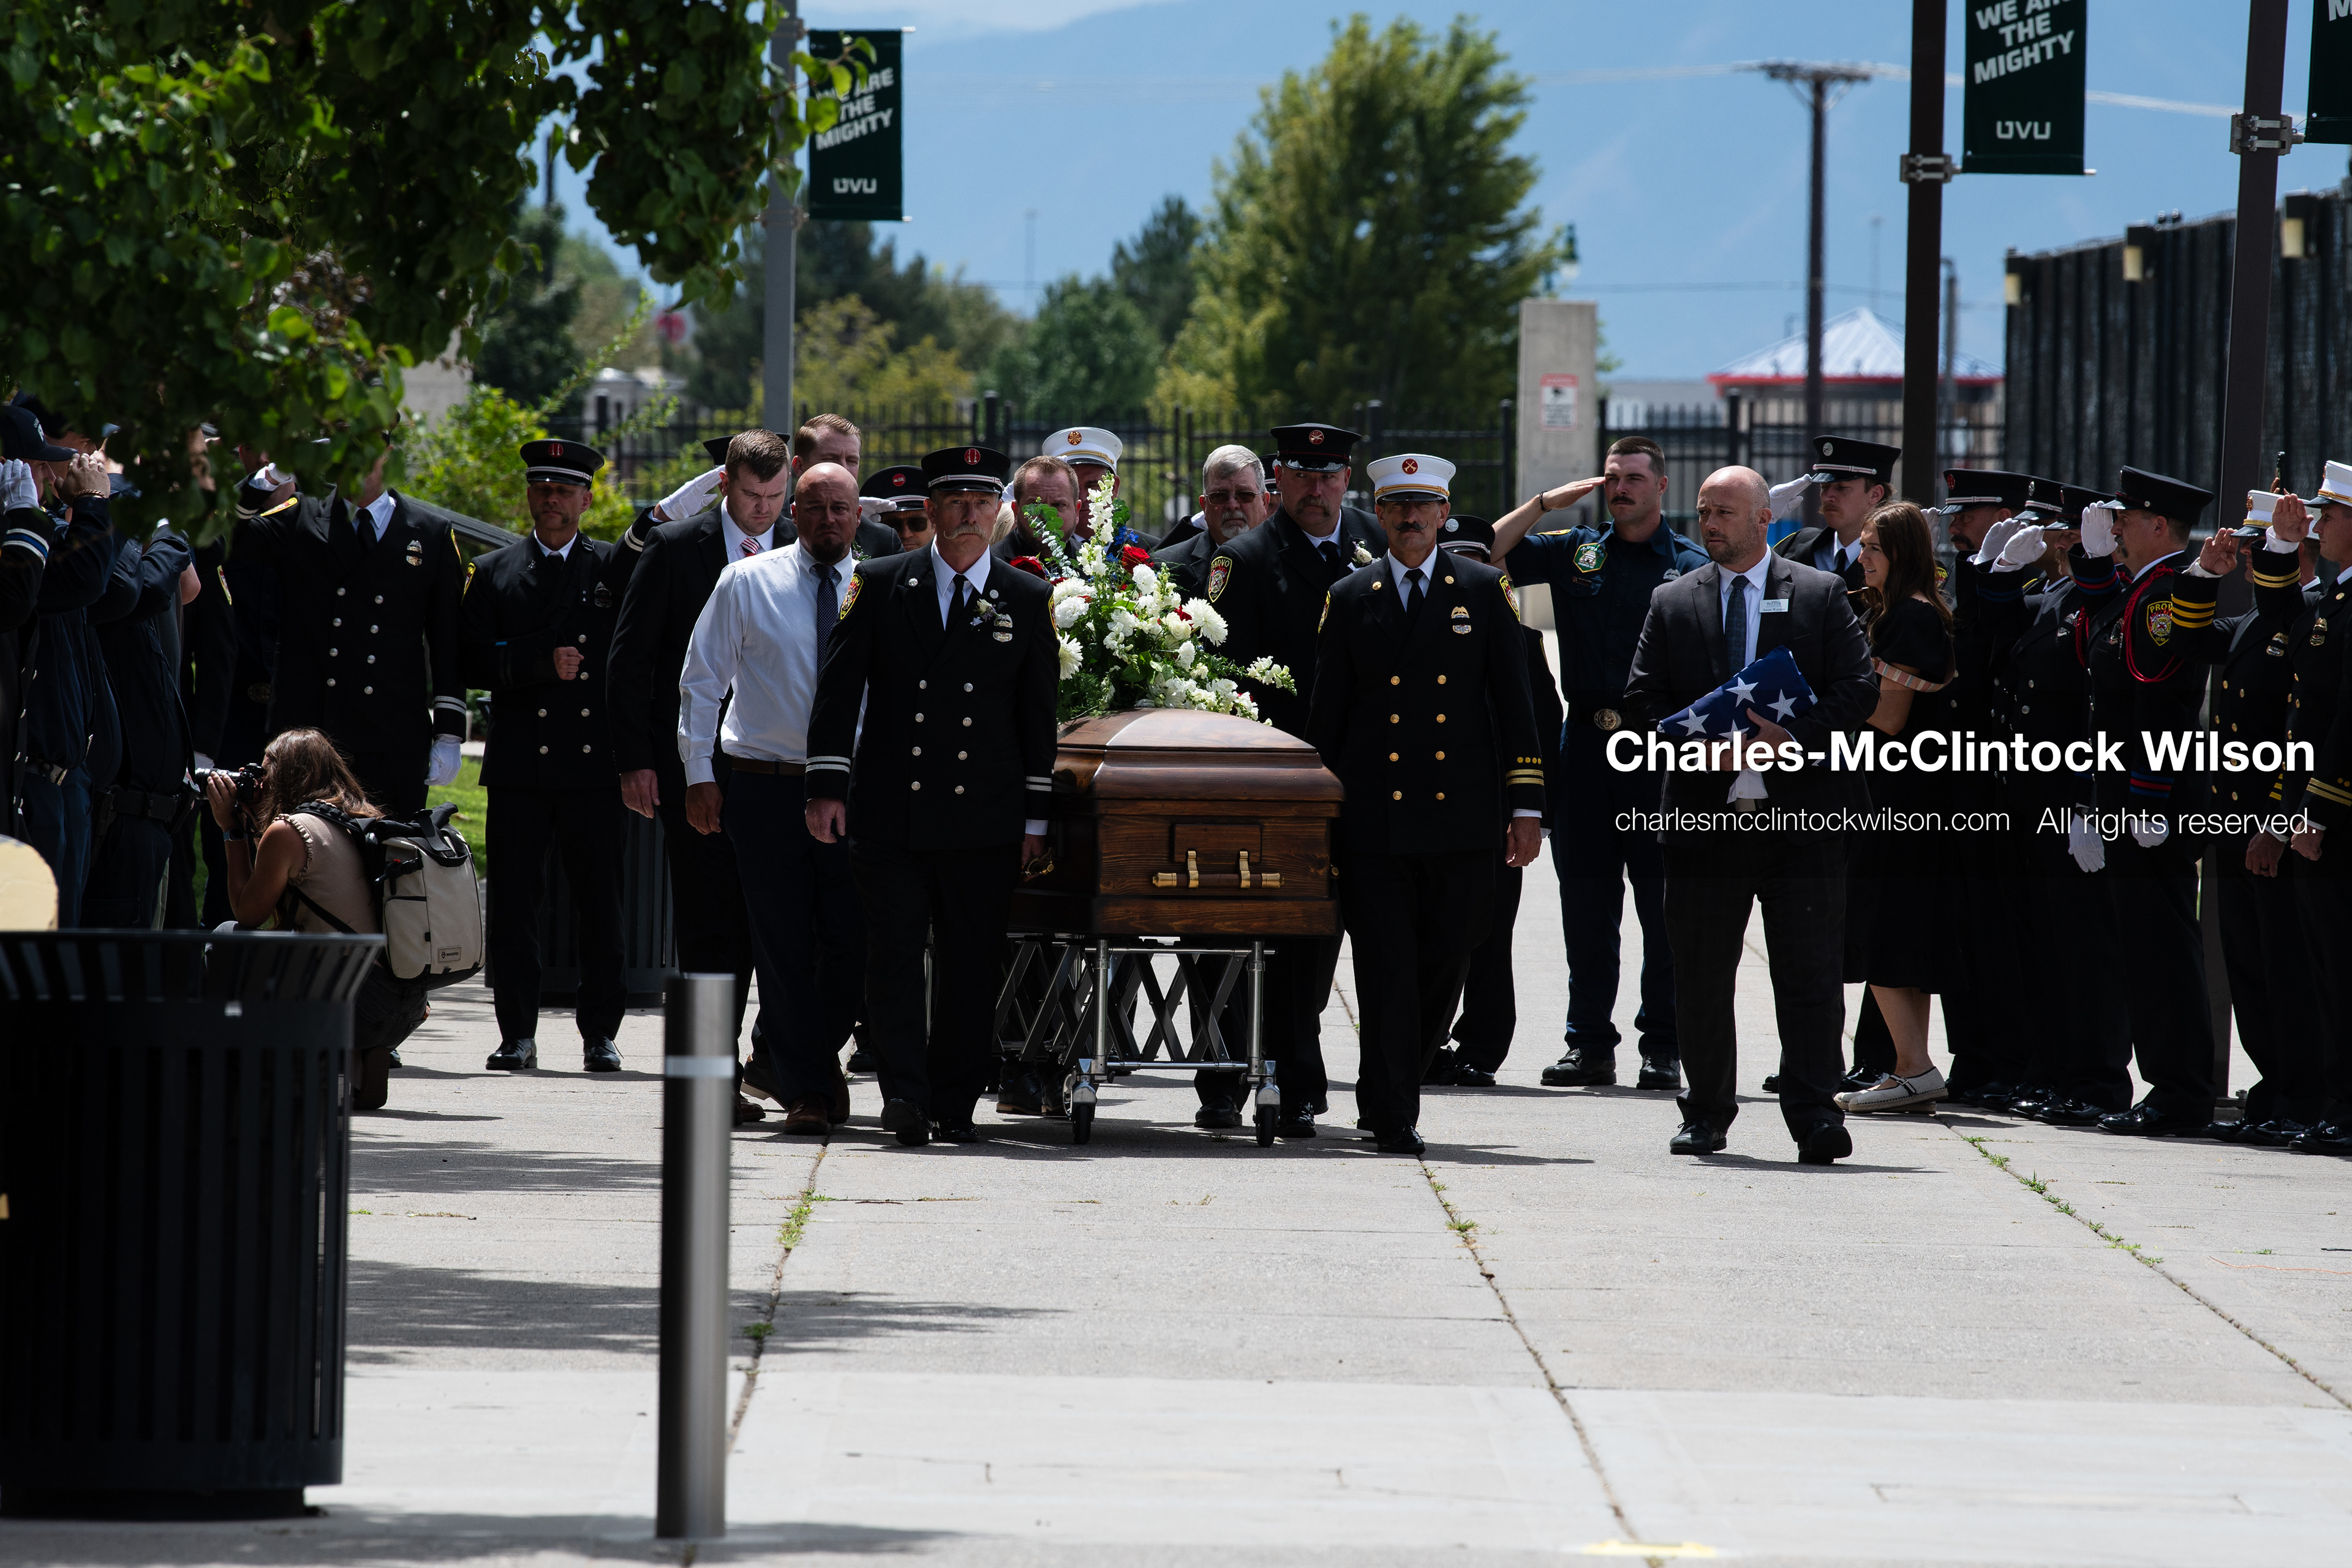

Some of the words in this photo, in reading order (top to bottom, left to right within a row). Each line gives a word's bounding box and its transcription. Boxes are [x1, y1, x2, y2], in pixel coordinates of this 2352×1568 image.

[1975, 0, 2018, 30] WE
[1999, 11, 2051, 48] THE
[1974, 29, 2075, 85] MIGHTY
[840, 94, 876, 122] THE
[815, 108, 894, 151] MIGHTY
[1996, 121, 2051, 140] UVU
[834, 177, 877, 194] UVU
[2150, 603, 2172, 612] PROV
